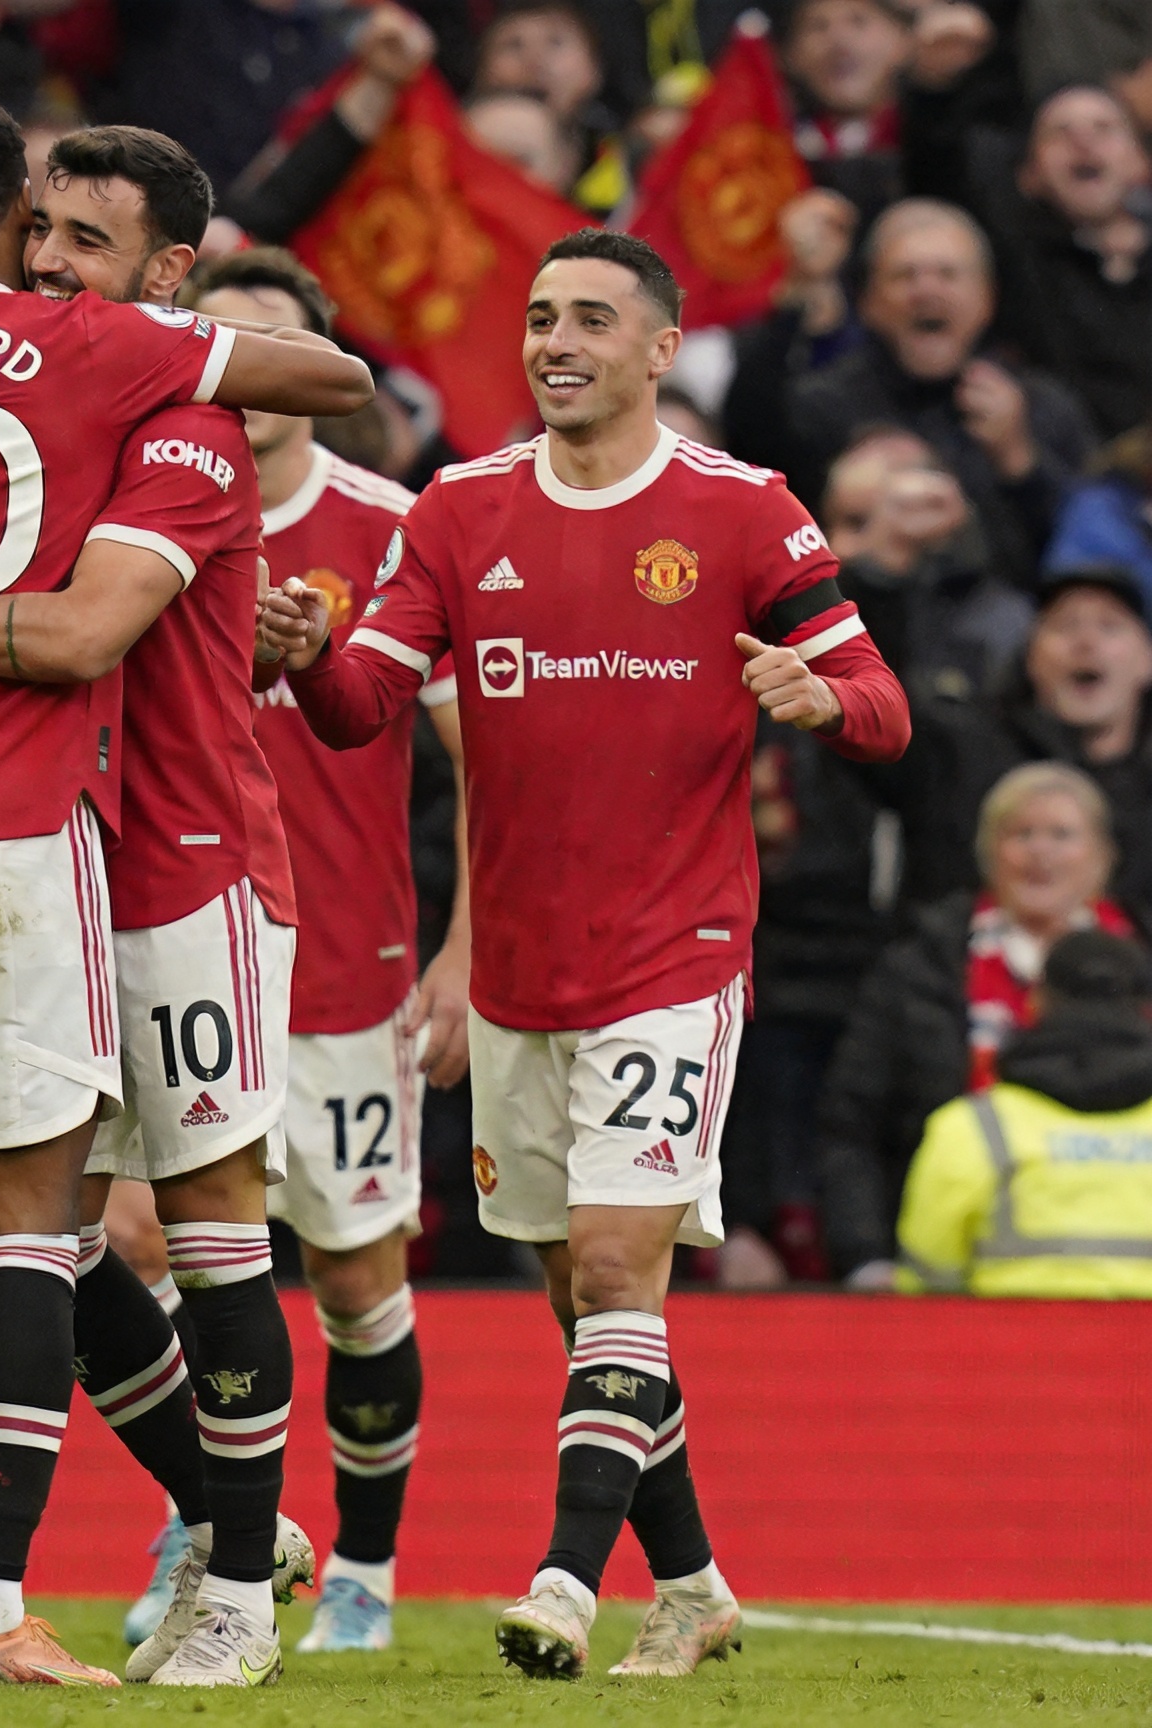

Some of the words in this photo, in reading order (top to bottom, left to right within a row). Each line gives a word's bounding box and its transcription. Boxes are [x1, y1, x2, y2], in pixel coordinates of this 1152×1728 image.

[142, 438, 235, 494] KOHLER
[784, 524, 828, 562] KO
[525, 649, 699, 681] TeamViewer
[151, 999, 233, 1088] 10
[602, 1051, 705, 1136] 25
[323, 1092, 393, 1171] 12
